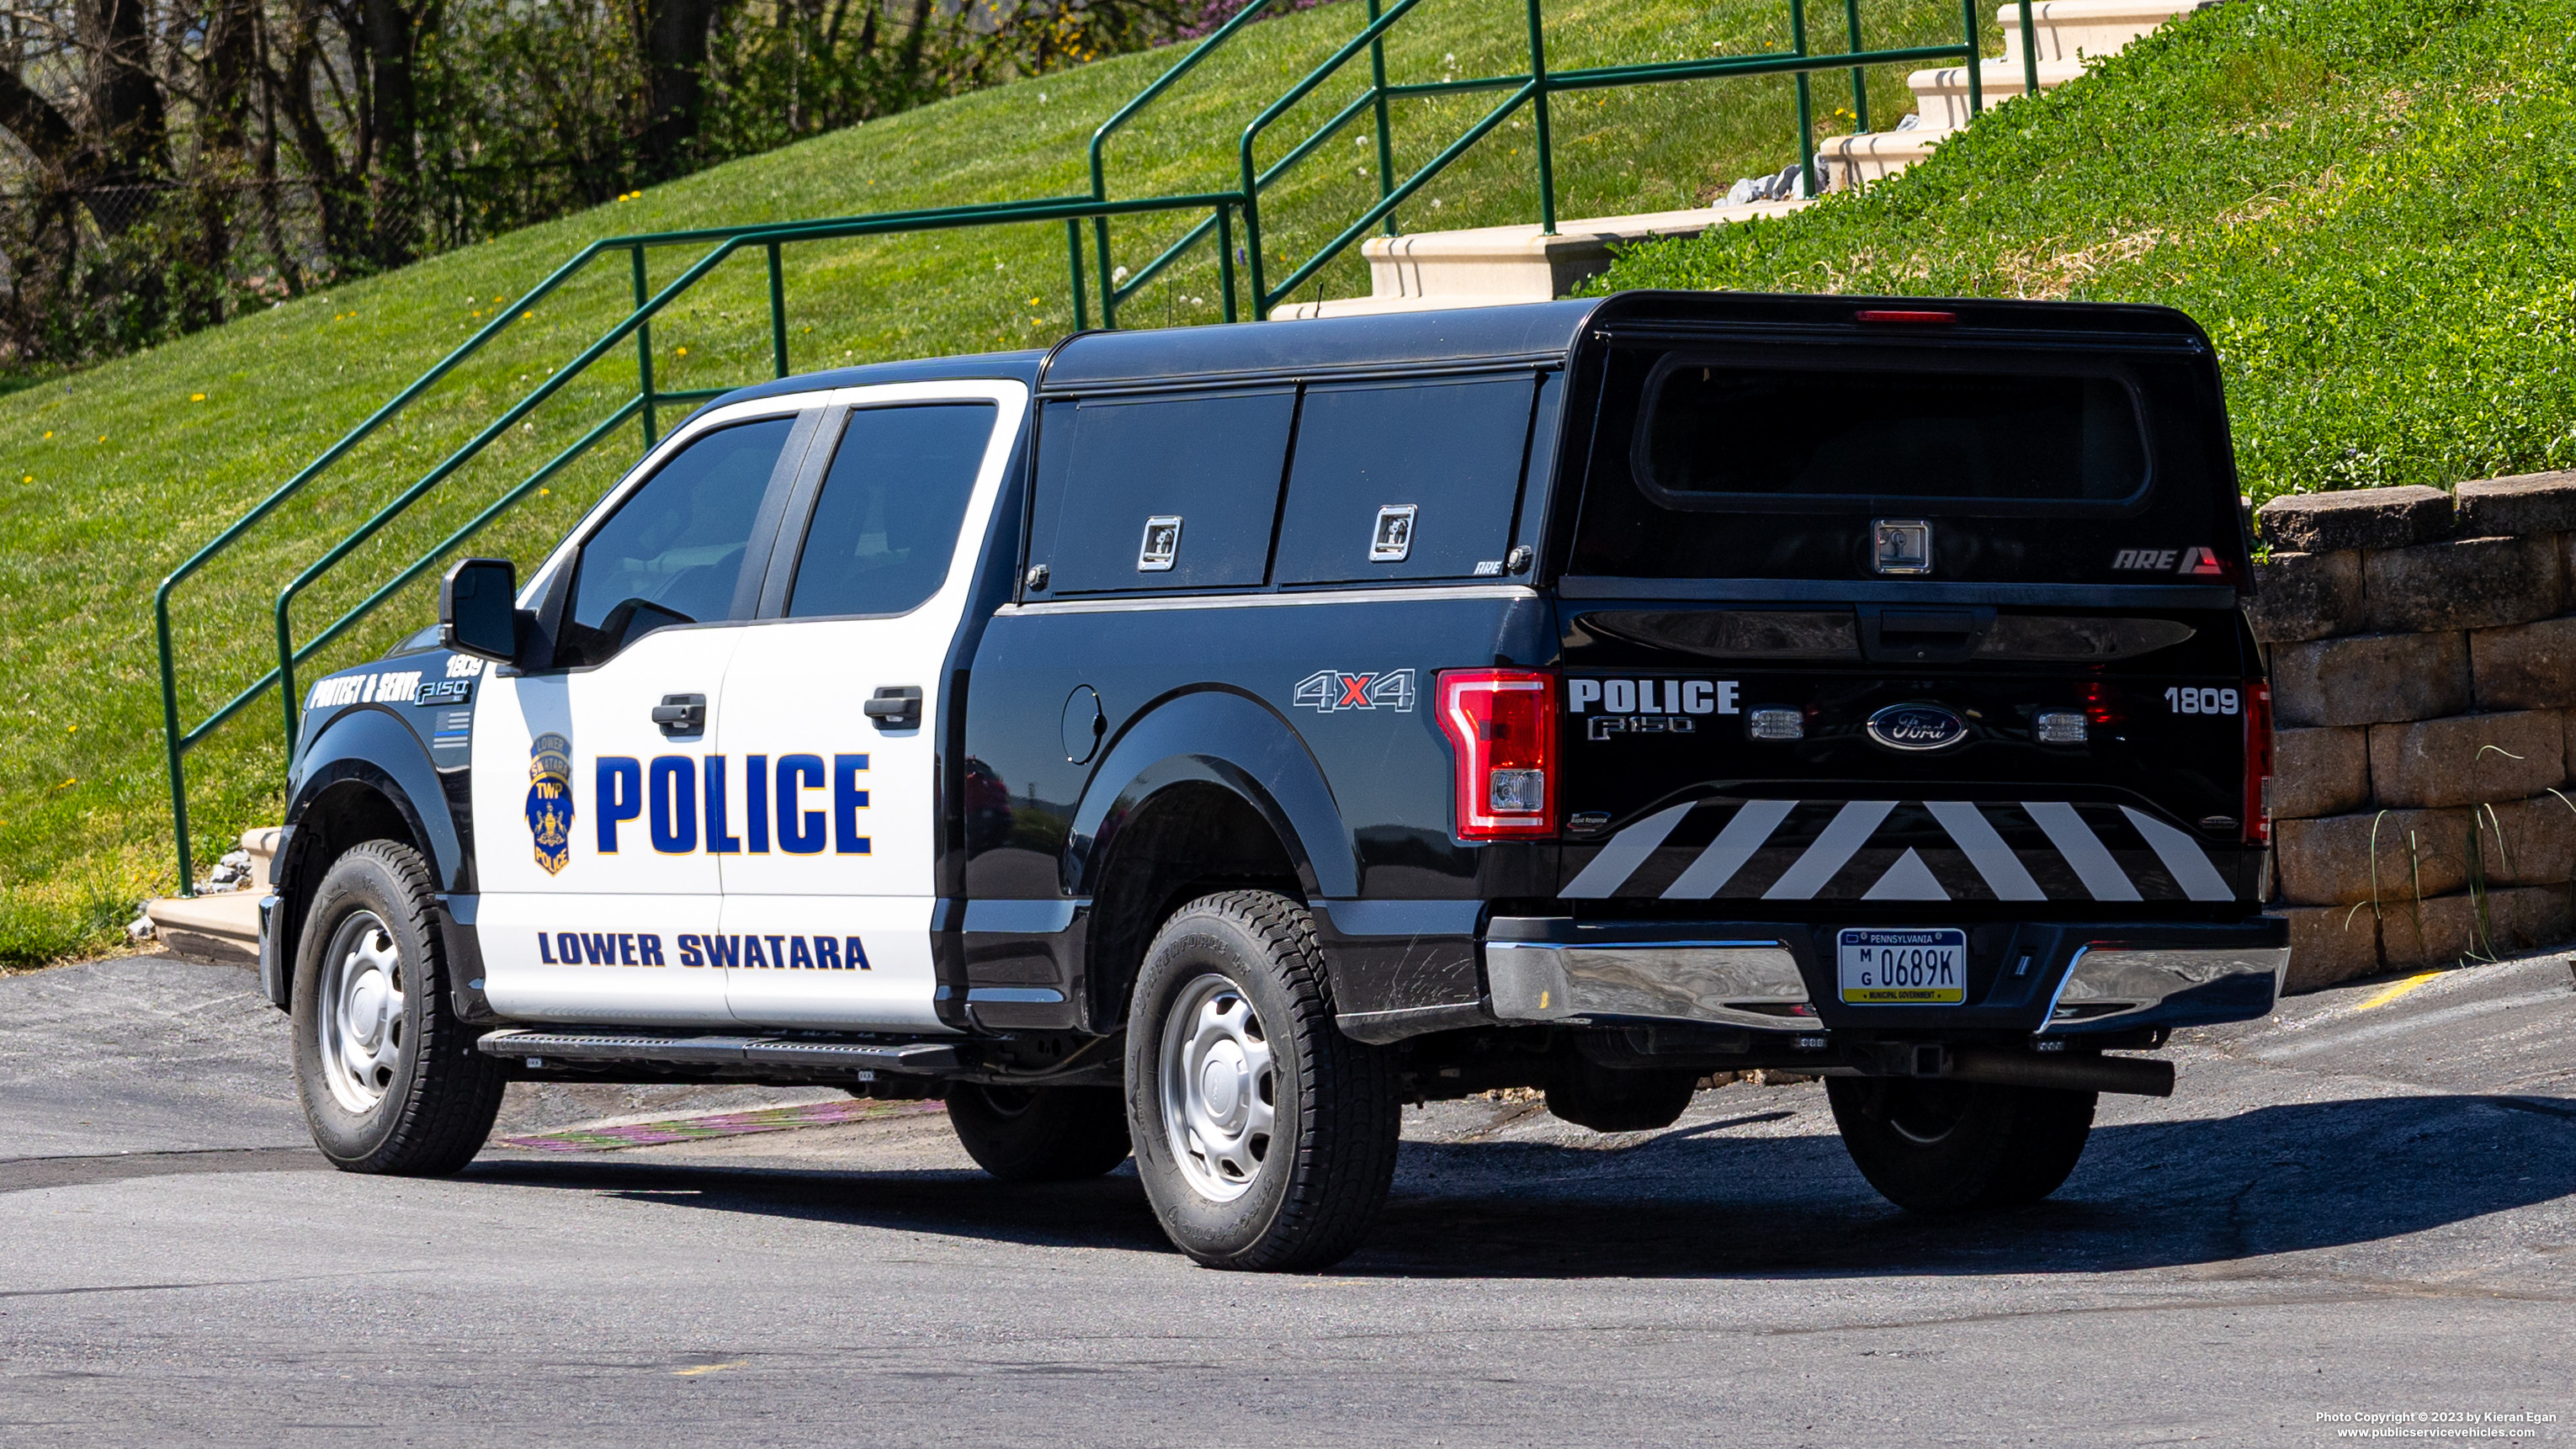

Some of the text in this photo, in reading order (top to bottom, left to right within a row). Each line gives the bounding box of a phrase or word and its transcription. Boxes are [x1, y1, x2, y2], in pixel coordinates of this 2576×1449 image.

[1473, 561, 1502, 575] ARE
[2111, 549, 2179, 569] ARE
[446, 654, 484, 678] 1809
[310, 671, 422, 709] PROTECT & SERVE
[1568, 679, 1739, 714] POLICE
[2164, 687, 2239, 714] 1809
[1892, 712, 1946, 740] Ford
[537, 737, 565, 752] LOWER
[531, 757, 568, 778] SWATARA
[536, 782, 563, 799] TWP
[595, 751, 873, 857] POLICE
[536, 847, 568, 872] POLICE
[537, 931, 873, 971] LOWER SWATARA
[1870, 934, 1933, 943] PENNSYLVANIA
[1136, 932, 1229, 1016] WINTERFORCE
[1881, 948, 1953, 986] 0689K
[1868, 990, 1935, 1000] MUNICIPAL GOVERNMENT
